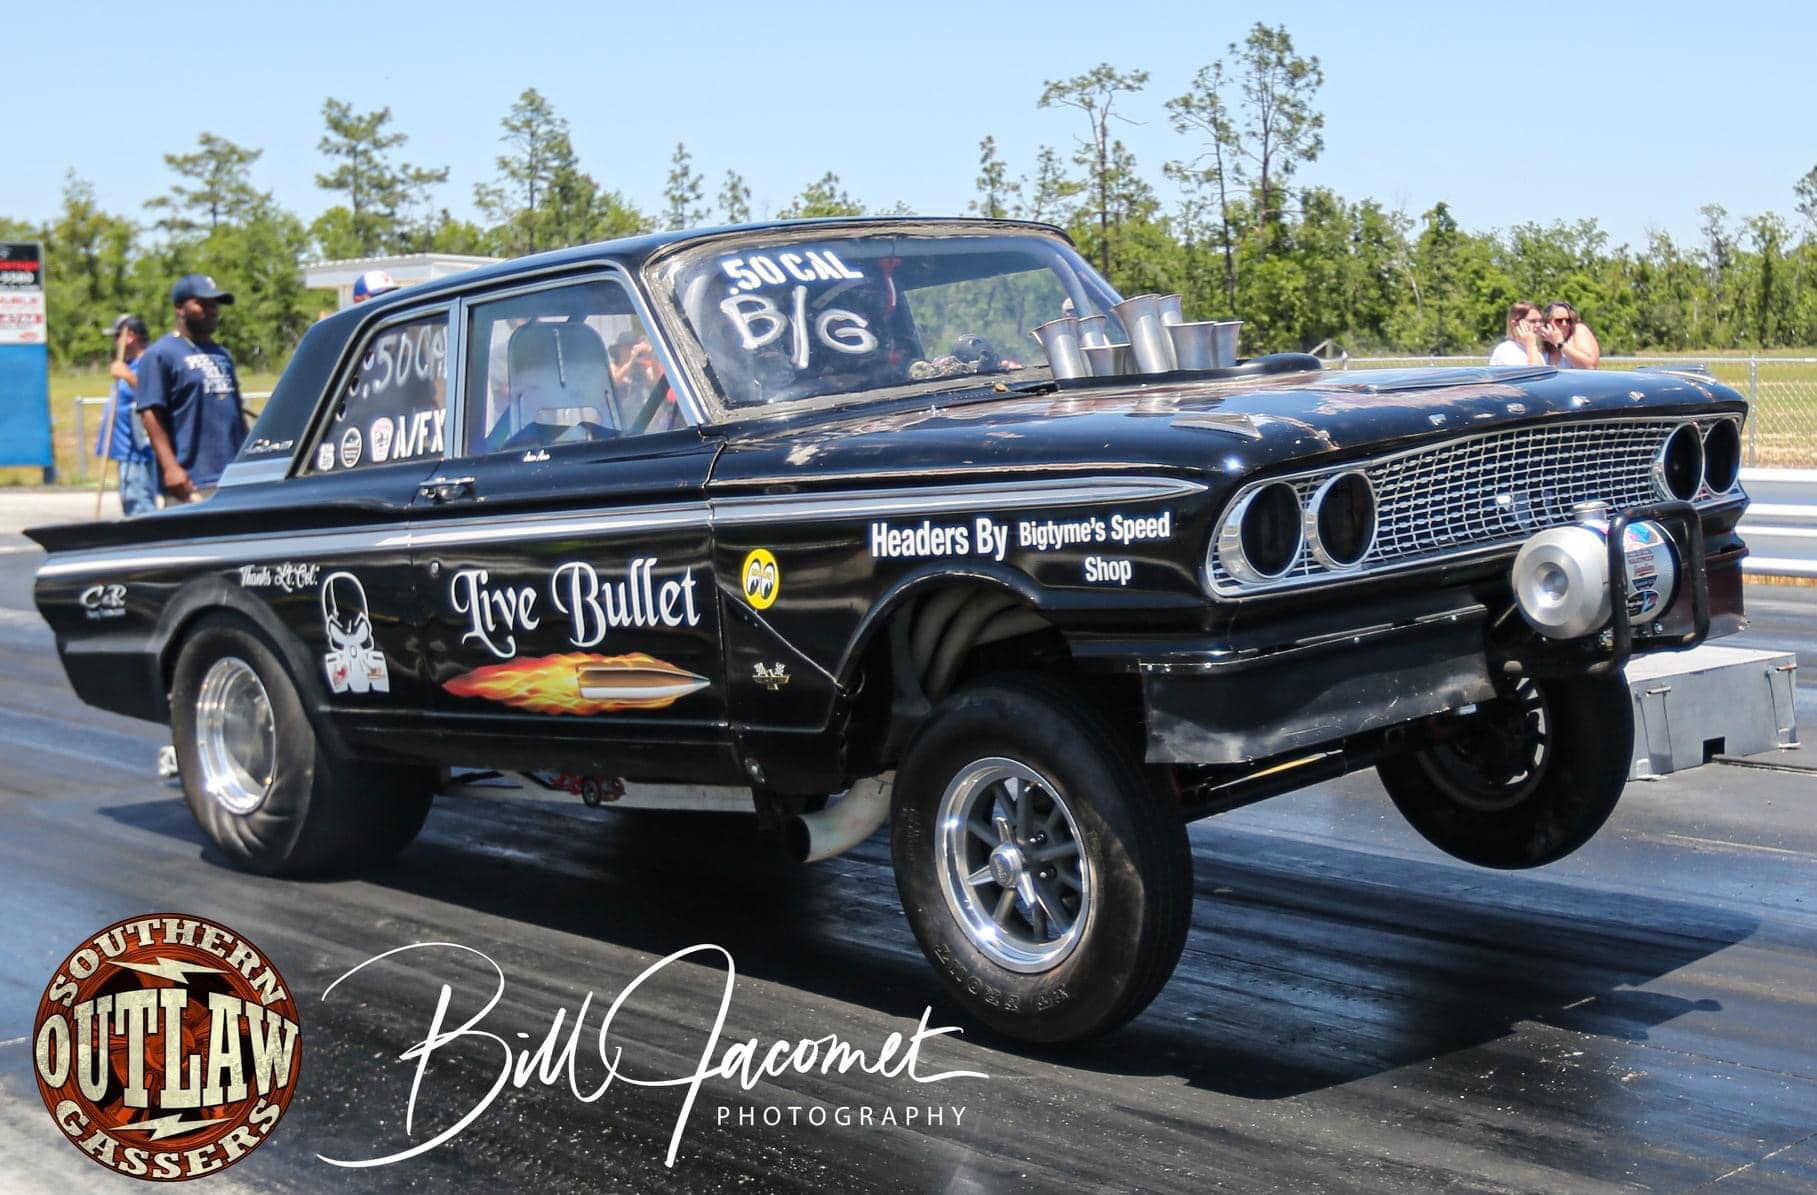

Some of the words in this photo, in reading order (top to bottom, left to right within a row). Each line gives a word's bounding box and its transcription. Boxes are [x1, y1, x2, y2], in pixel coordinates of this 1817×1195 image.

[721, 255, 787, 295] .50
[779, 251, 865, 282] CAL
[719, 285, 879, 369] B/G
[392, 408, 447, 459] A/FX
[871, 520, 970, 558] Headers
[976, 517, 1008, 561] By
[1019, 516, 1106, 551] Bigtyme's
[1111, 512, 1171, 545] Speed
[239, 564, 272, 588] Thanks
[1084, 556, 1132, 585] Shop
[451, 569, 541, 658] Live
[551, 557, 700, 648] Bullet
